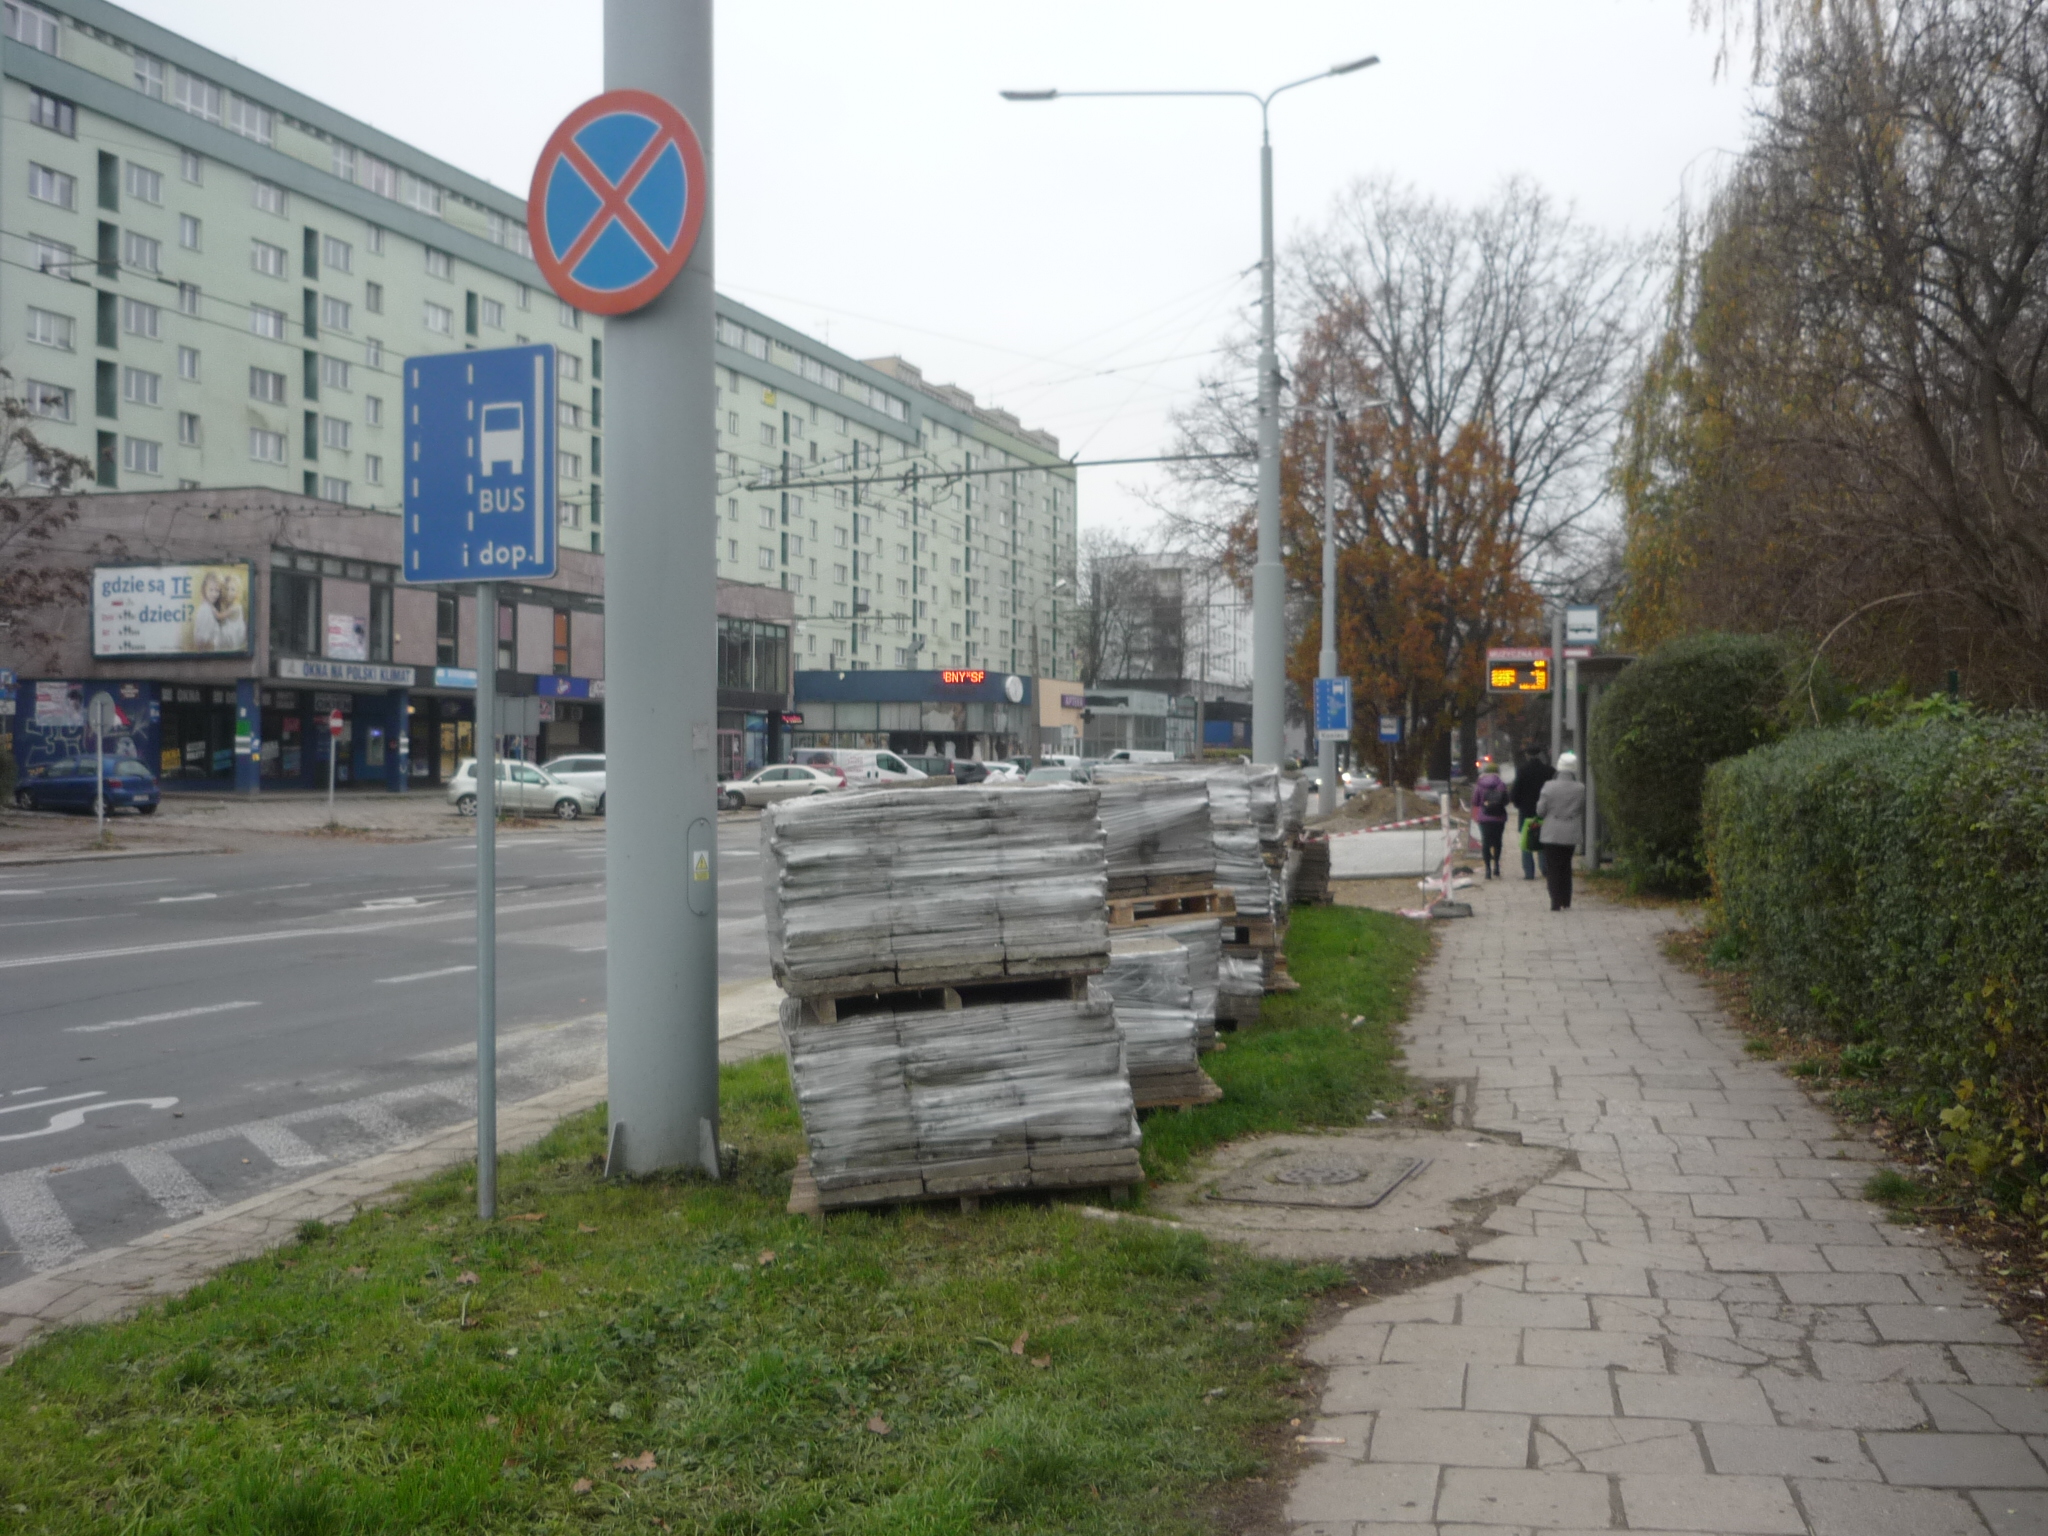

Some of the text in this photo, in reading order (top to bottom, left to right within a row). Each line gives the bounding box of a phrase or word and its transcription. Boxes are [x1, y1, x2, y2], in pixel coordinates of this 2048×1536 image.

[480, 486, 525, 513] BUS
[463, 540, 534, 570] i dop.
[102, 575, 193, 597] gdzie są TE
[138, 604, 195, 623] dzieci?
[303, 661, 411, 683] OKNA NA POLSKI KLIMAT
